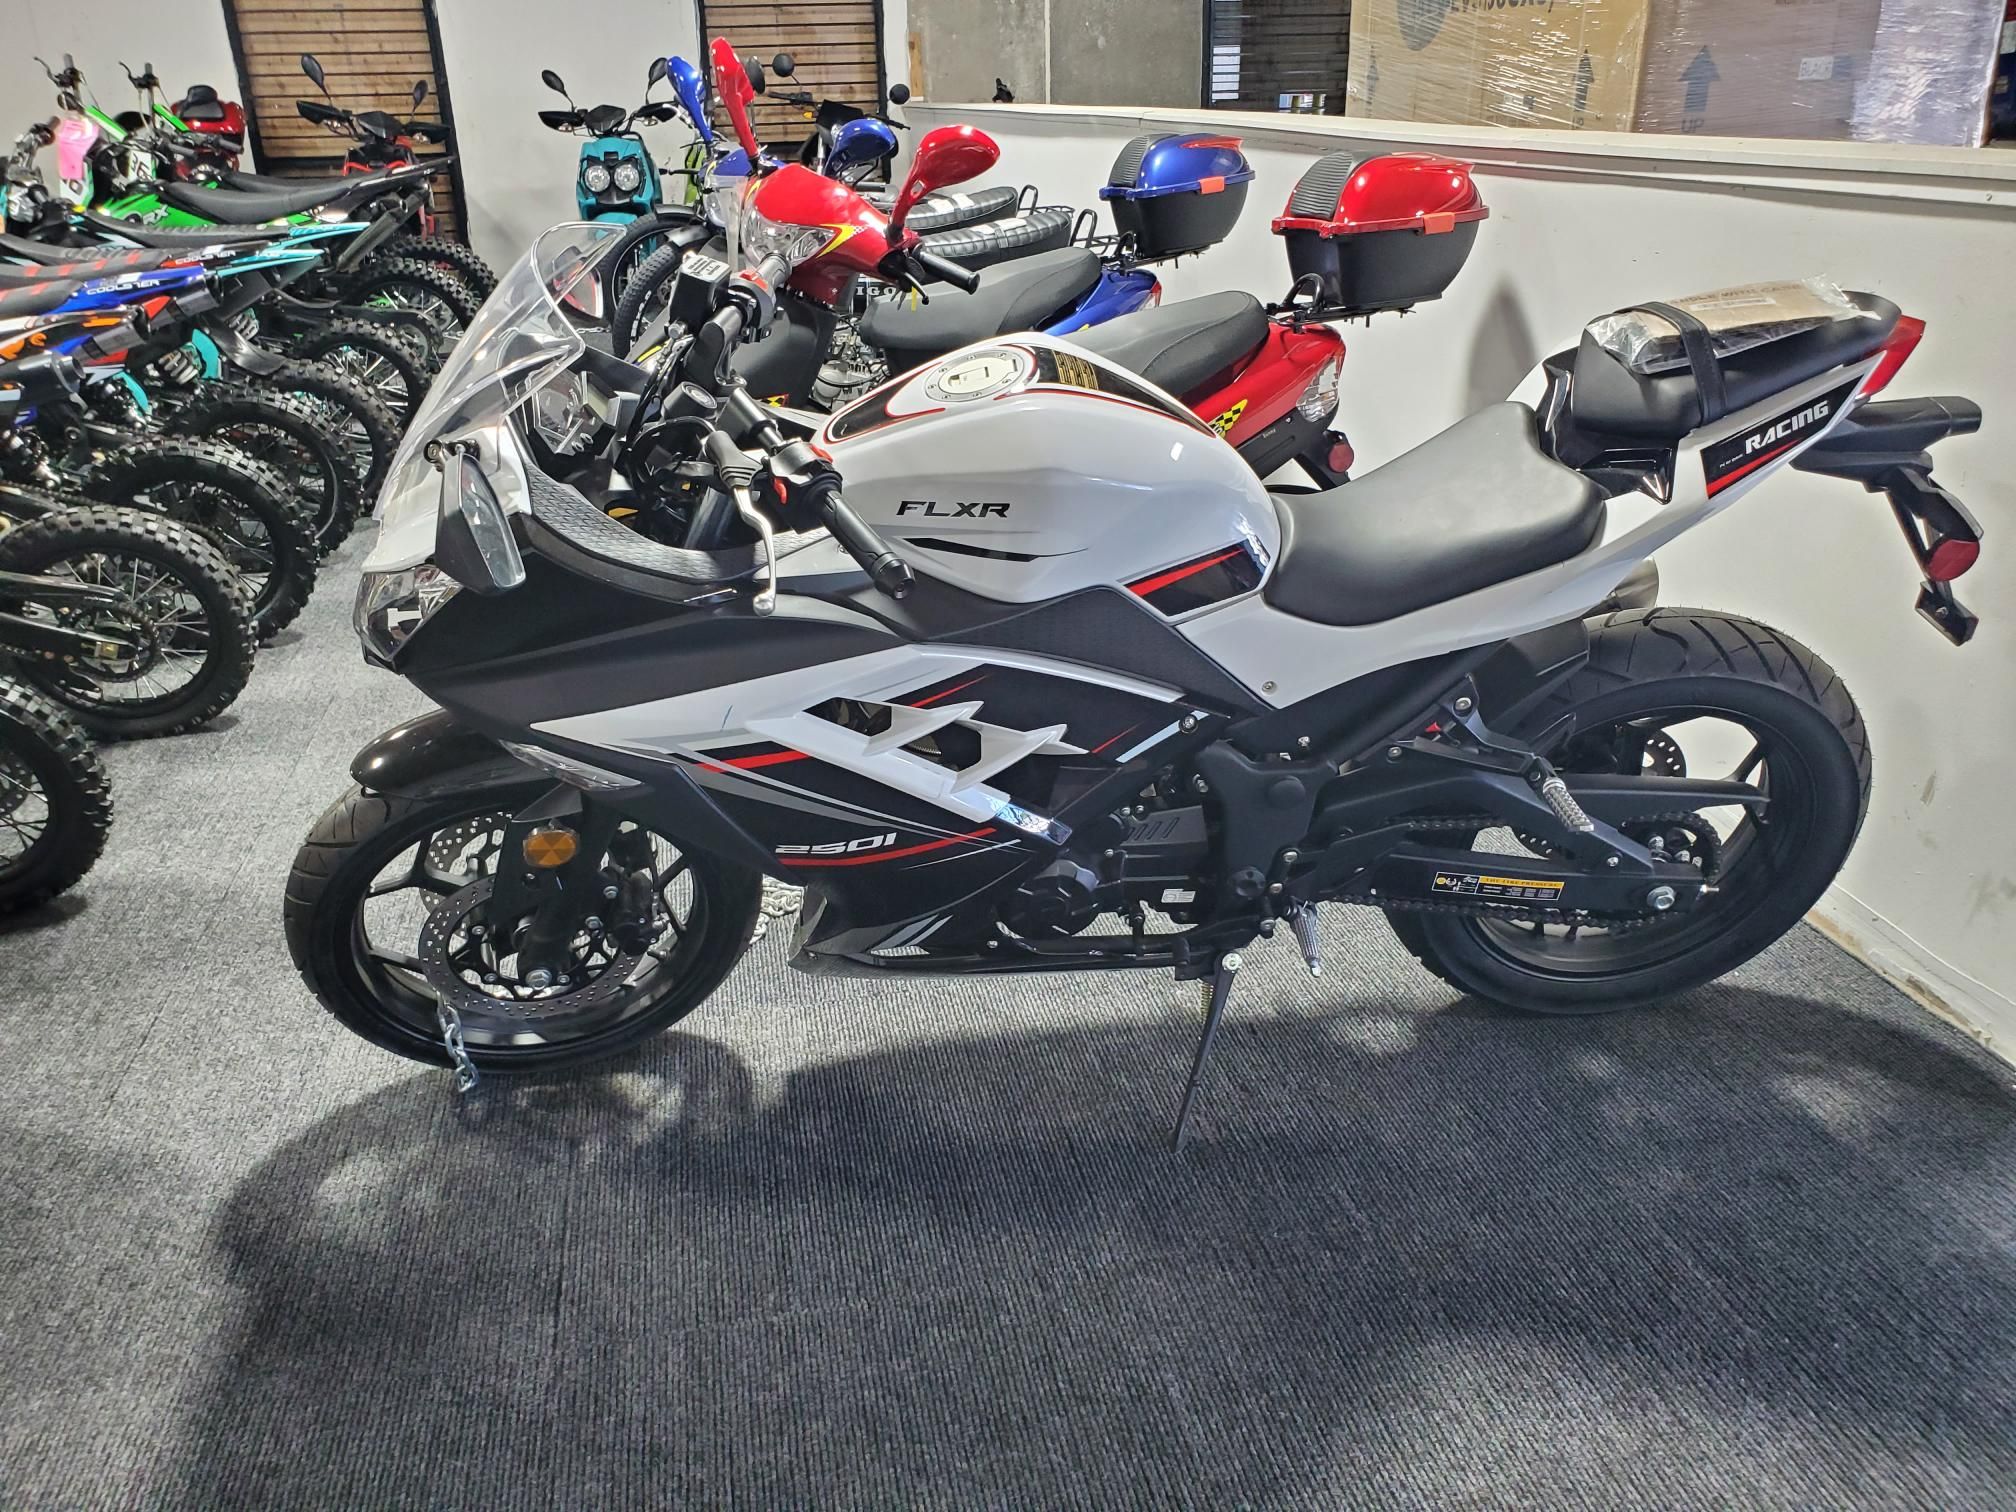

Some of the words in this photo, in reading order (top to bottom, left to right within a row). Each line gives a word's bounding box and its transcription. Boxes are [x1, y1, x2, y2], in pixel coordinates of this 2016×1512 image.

[1681, 119, 1705, 133] UP
[175, 251, 237, 265] COOLSTER
[87, 279, 161, 296] COOLSTER
[1745, 400, 1829, 455] RACING
[896, 500, 1011, 518] FLXR
